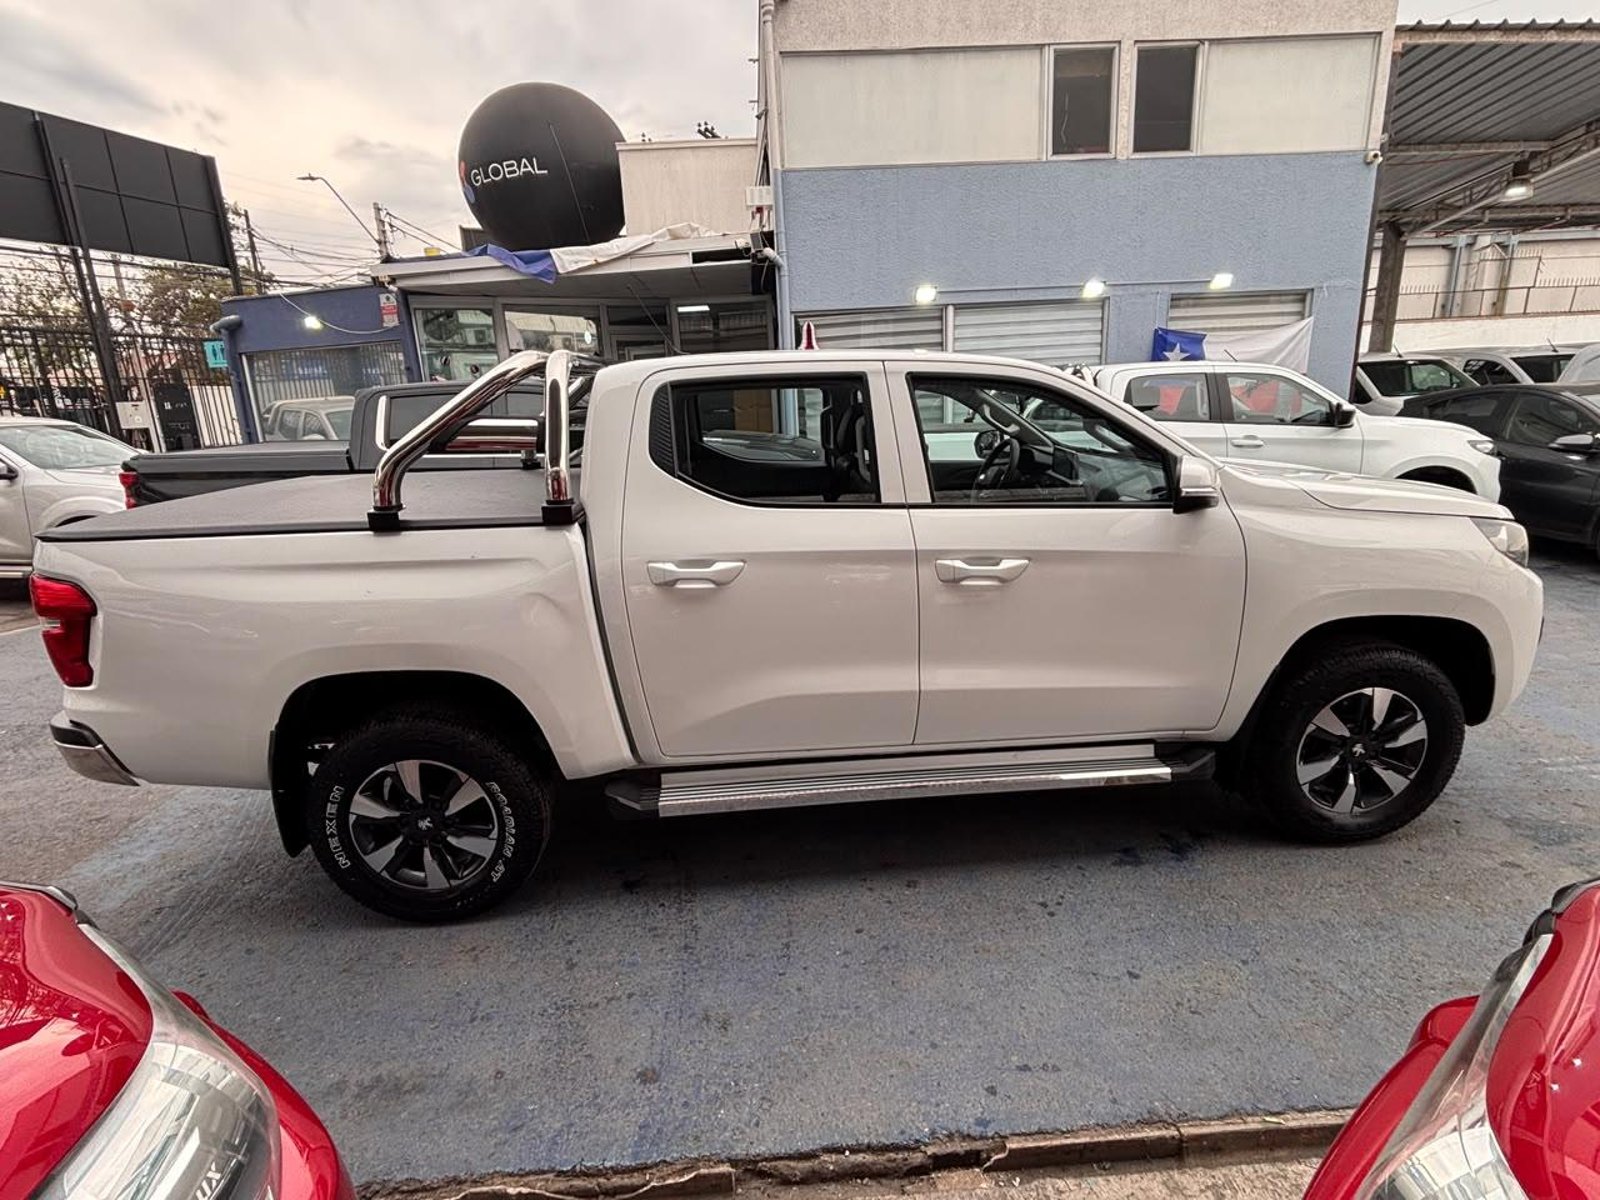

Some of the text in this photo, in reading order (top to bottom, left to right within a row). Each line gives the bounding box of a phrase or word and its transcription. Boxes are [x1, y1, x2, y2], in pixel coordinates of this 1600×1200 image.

[470, 156, 548, 187] GLOBAL
[325, 785, 351, 869] NEXEN
[485, 781, 516, 858] ROADIAN
